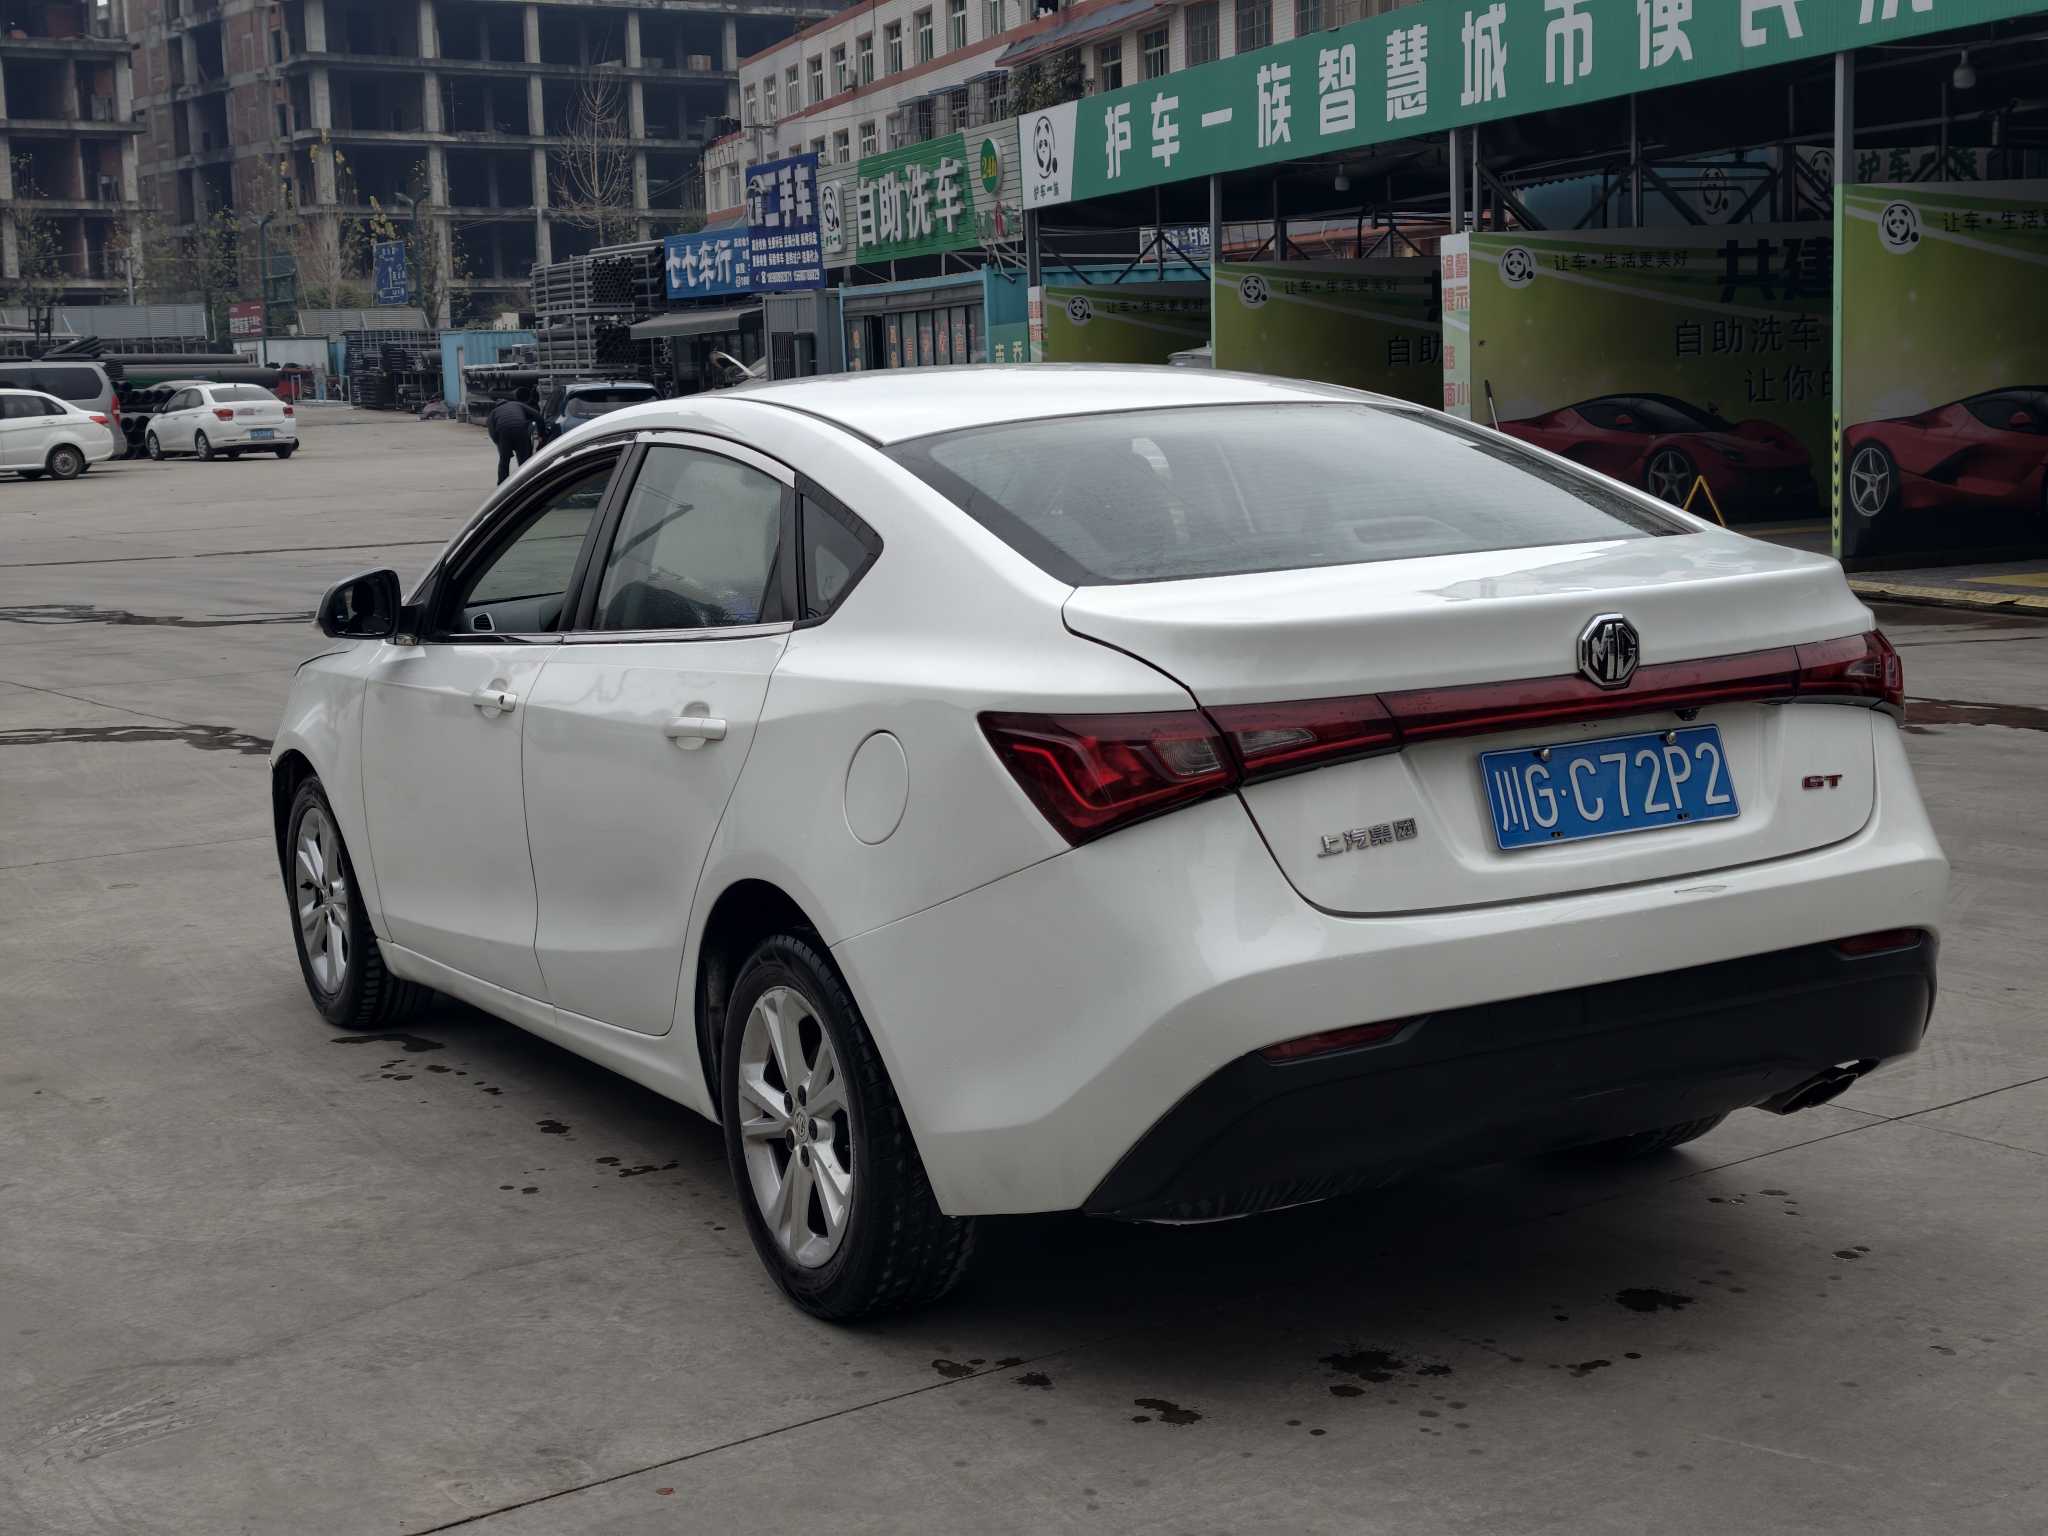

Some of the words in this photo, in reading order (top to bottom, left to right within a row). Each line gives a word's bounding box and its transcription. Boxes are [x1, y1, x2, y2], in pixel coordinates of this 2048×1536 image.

[1104, 0, 1934, 179] 护车一族智慧城市便
[762, 163, 812, 228] 二手车
[857, 156, 966, 249] 自助洗车
[665, 239, 732, 291] 七七车行
[1553, 249, 1689, 272] 让车·生活更美好
[1674, 314, 1821, 357] 自助洗车
[1589, 621, 1638, 681] MG
[1494, 742, 1731, 833] 川G·C72P2
[1801, 772, 1844, 791] GT
[1316, 816, 1419, 859] 上汽集团
